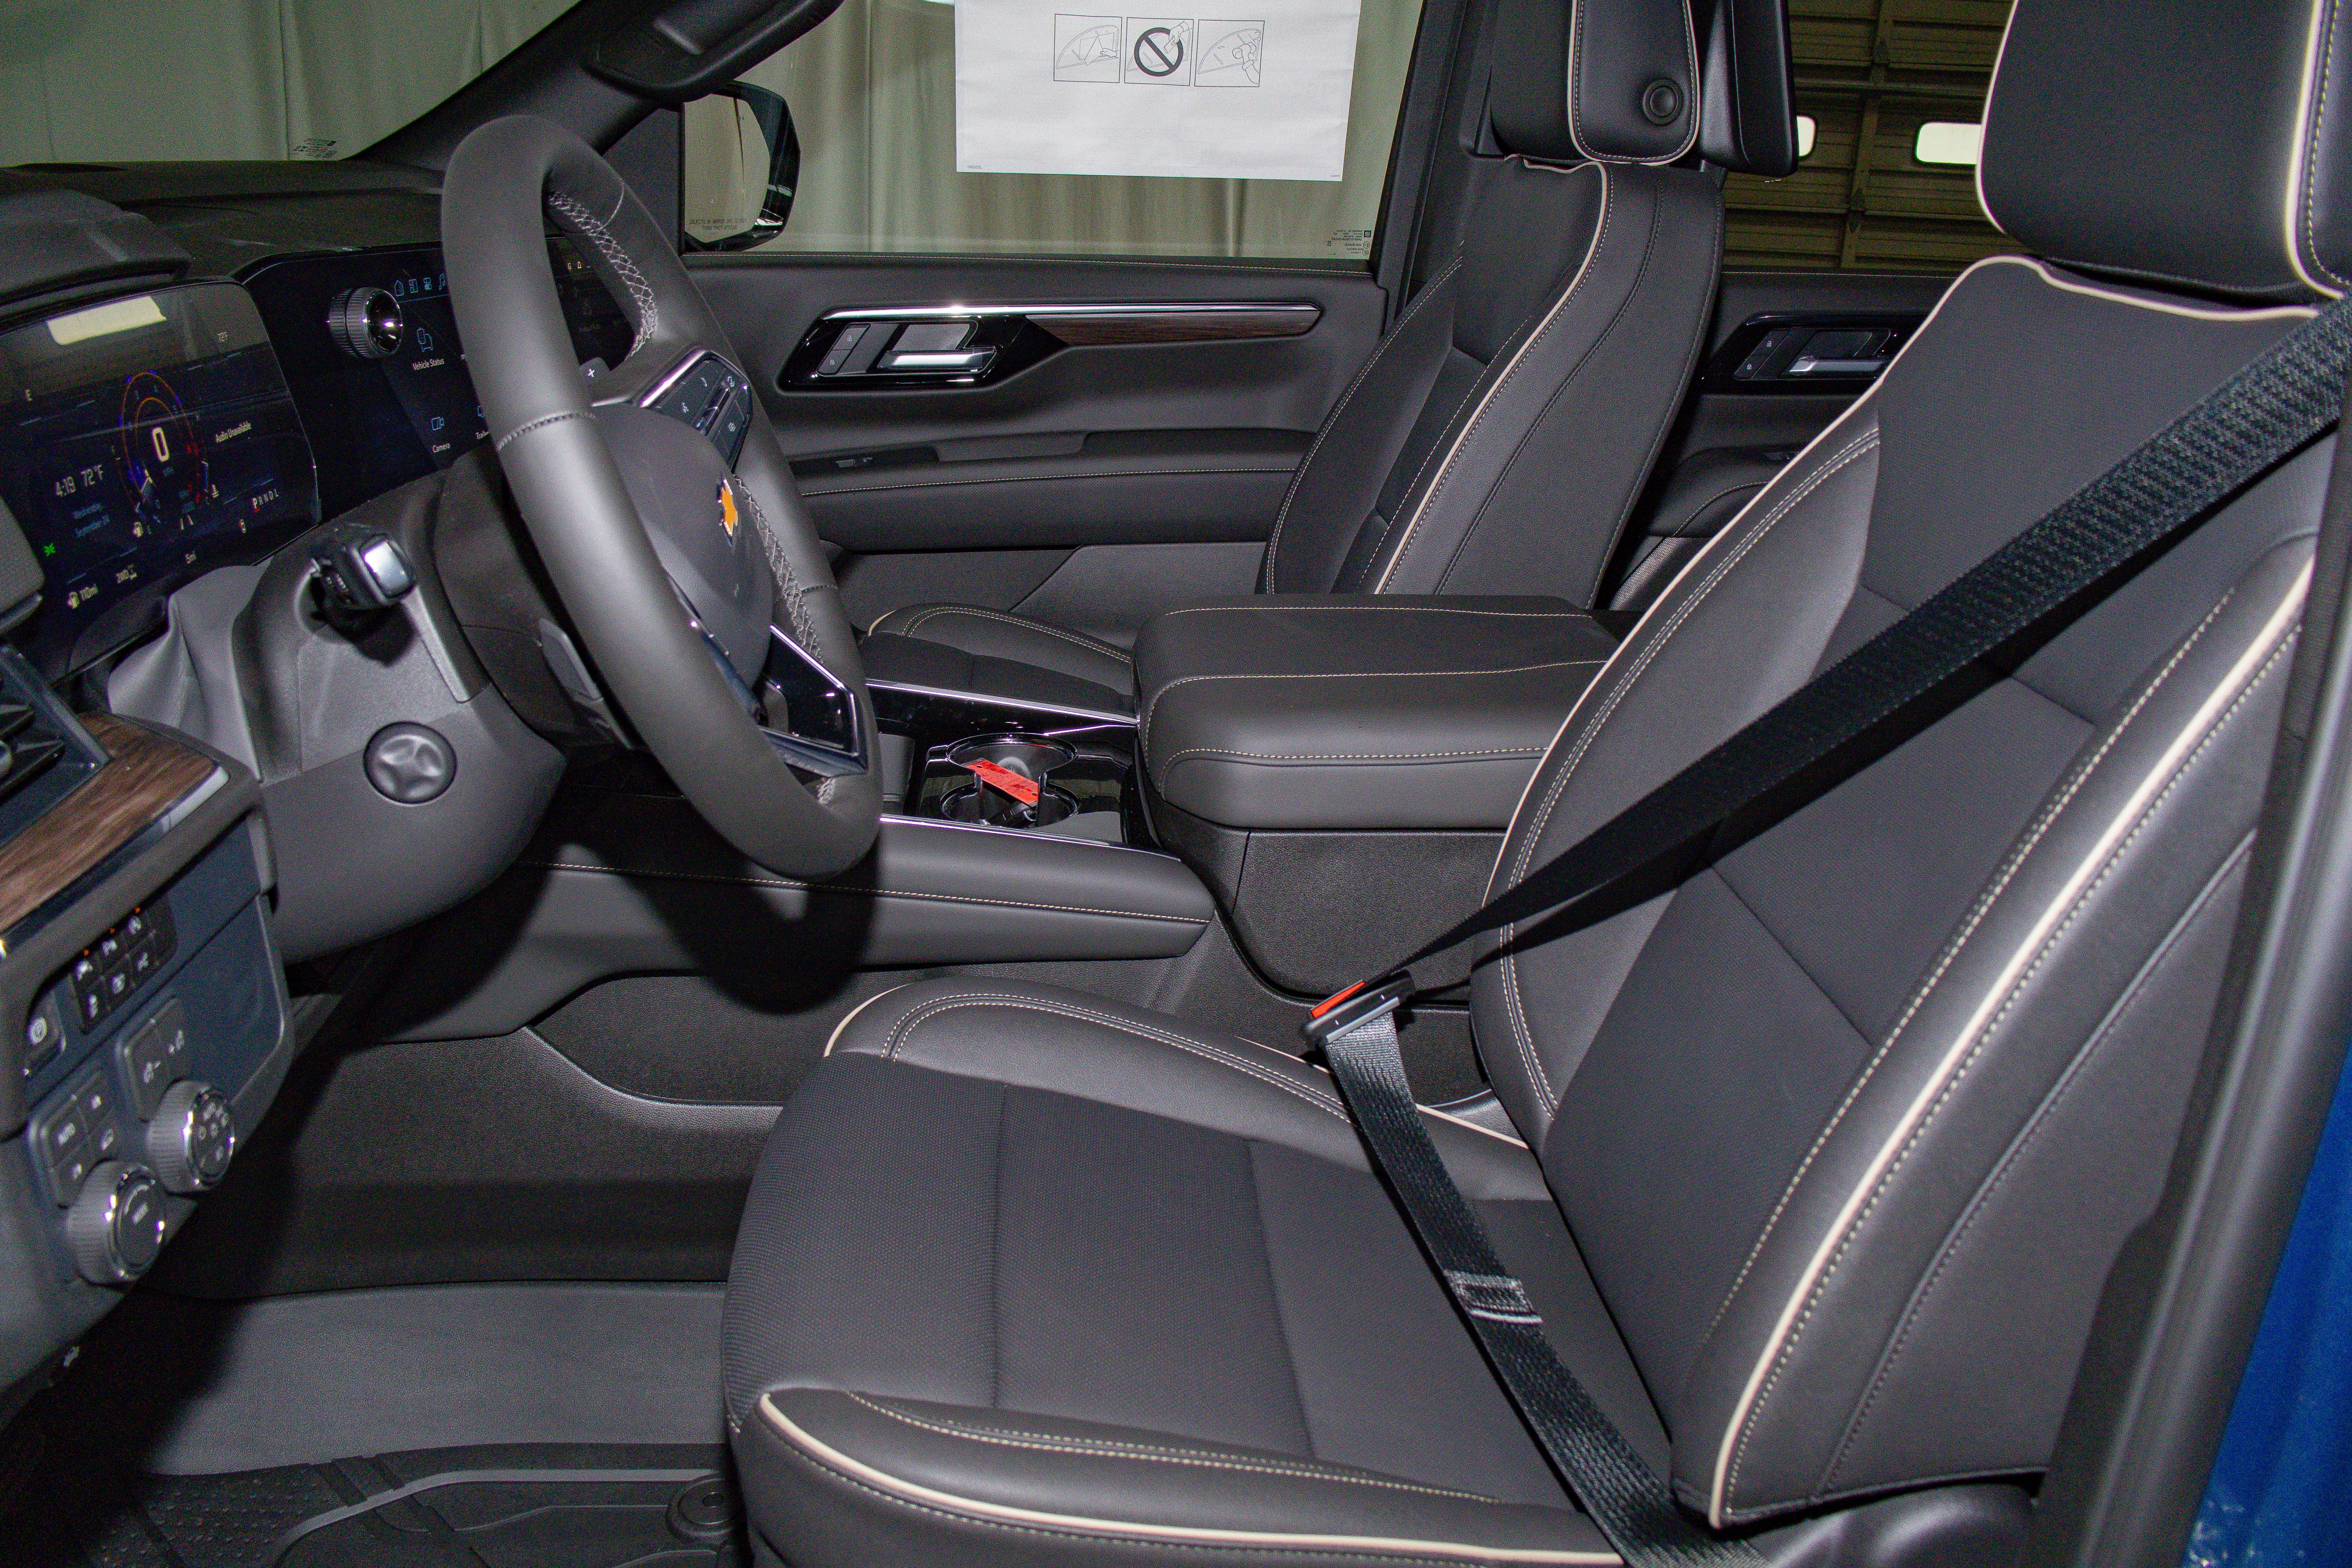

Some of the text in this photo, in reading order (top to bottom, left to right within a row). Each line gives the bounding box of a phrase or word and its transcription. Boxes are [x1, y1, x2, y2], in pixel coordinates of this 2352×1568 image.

[412, 358, 445, 370] Vehicle Status
[216, 431, 229, 444] Audio
[151, 426, 170, 463] 0
[432, 443, 451, 453] Camera
[56, 464, 104, 497] 4:19 72°F
